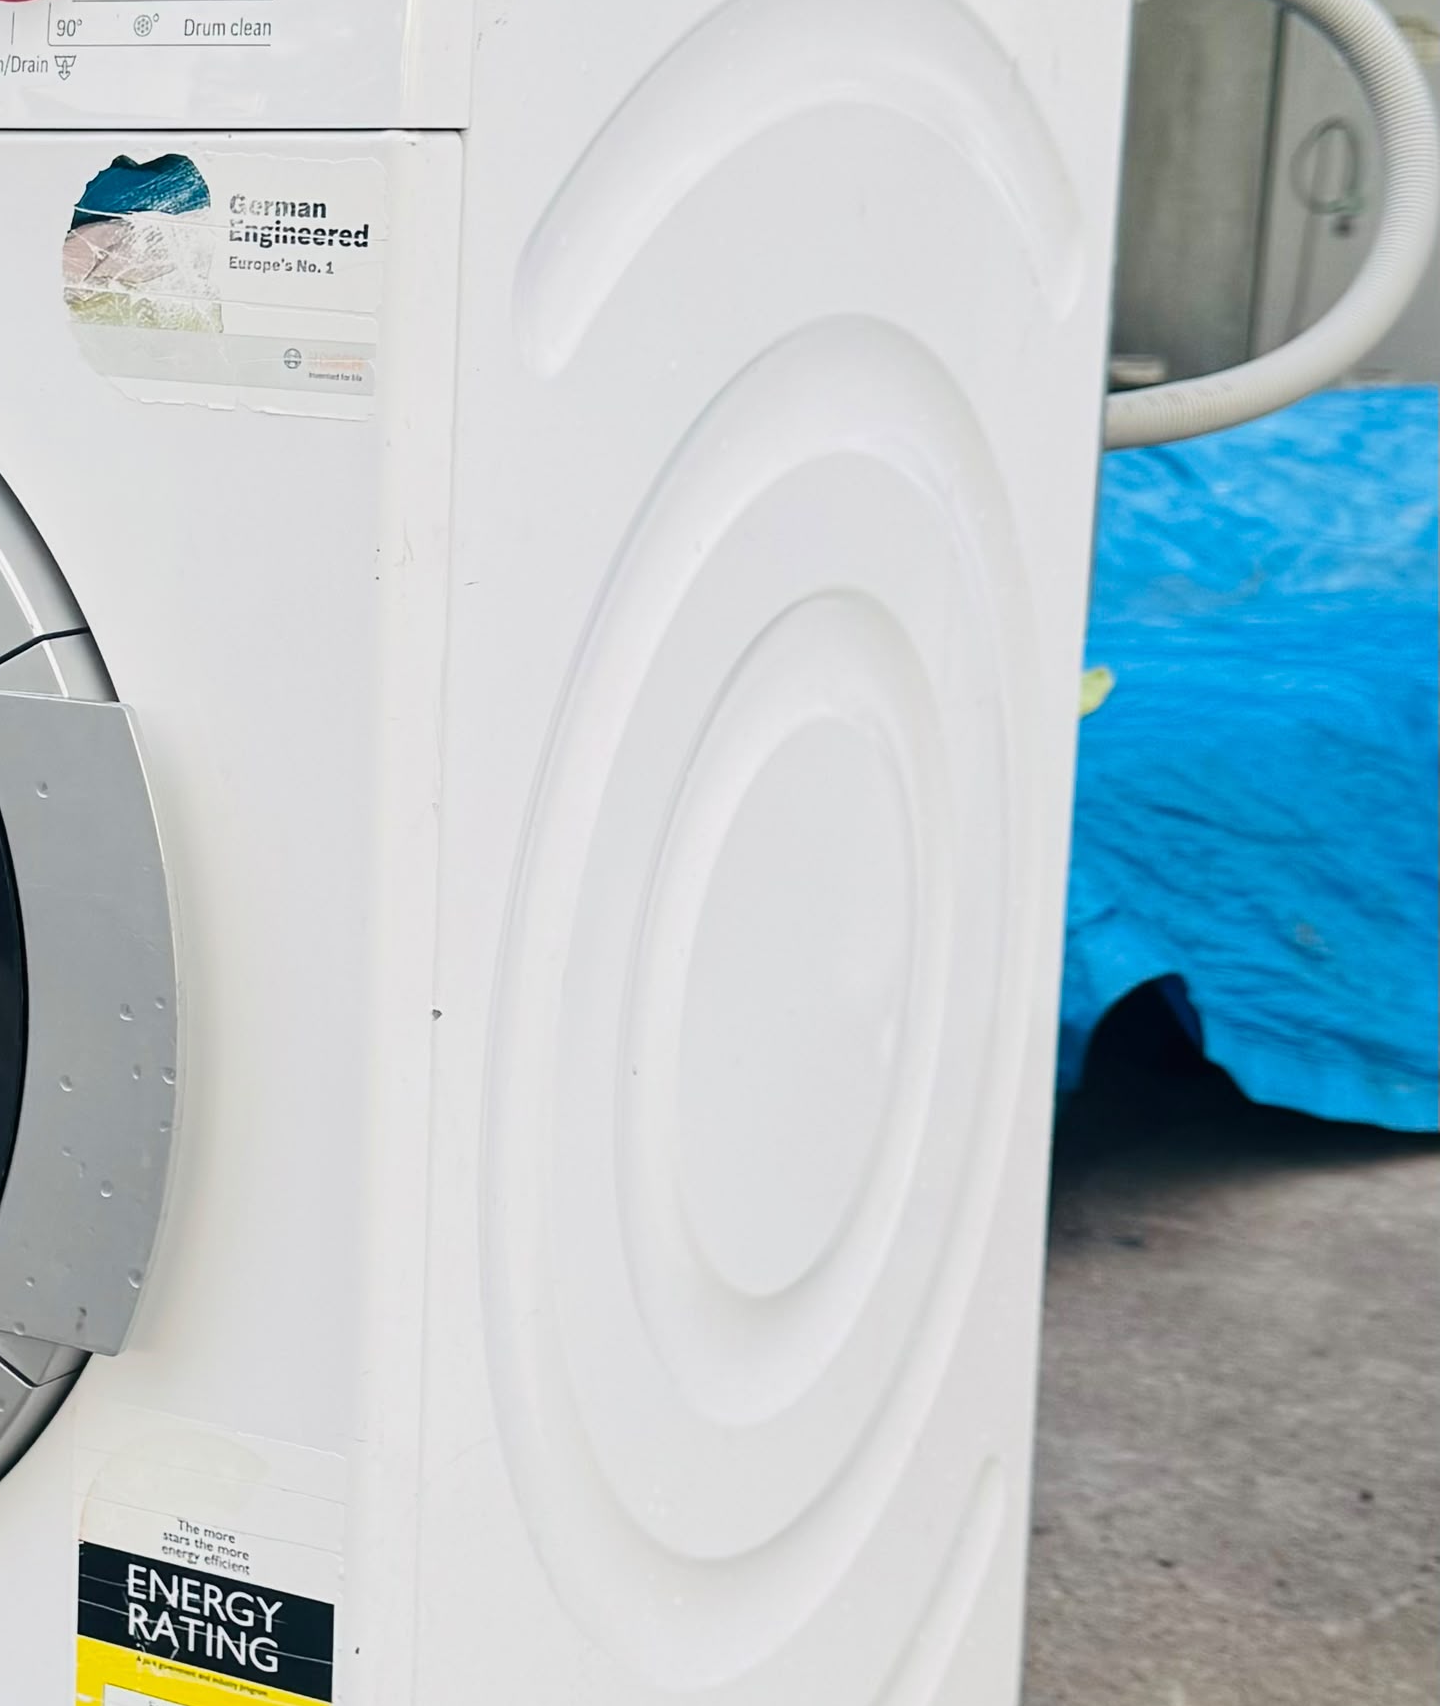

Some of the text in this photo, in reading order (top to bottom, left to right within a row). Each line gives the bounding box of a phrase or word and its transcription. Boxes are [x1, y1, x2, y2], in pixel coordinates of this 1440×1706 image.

[56, 17, 272, 37] 90° Drum clean
[230, 194, 327, 219] German
[229, 219, 370, 248] Engineered
[229, 256, 335, 275] Europe's No. 1
[178, 1518, 236, 1544] The more
[161, 1545, 251, 1576] energy efficient
[163, 1532, 250, 1561] stars the more
[127, 1563, 284, 1634] ENERGY
[127, 1602, 280, 1675] RATING
